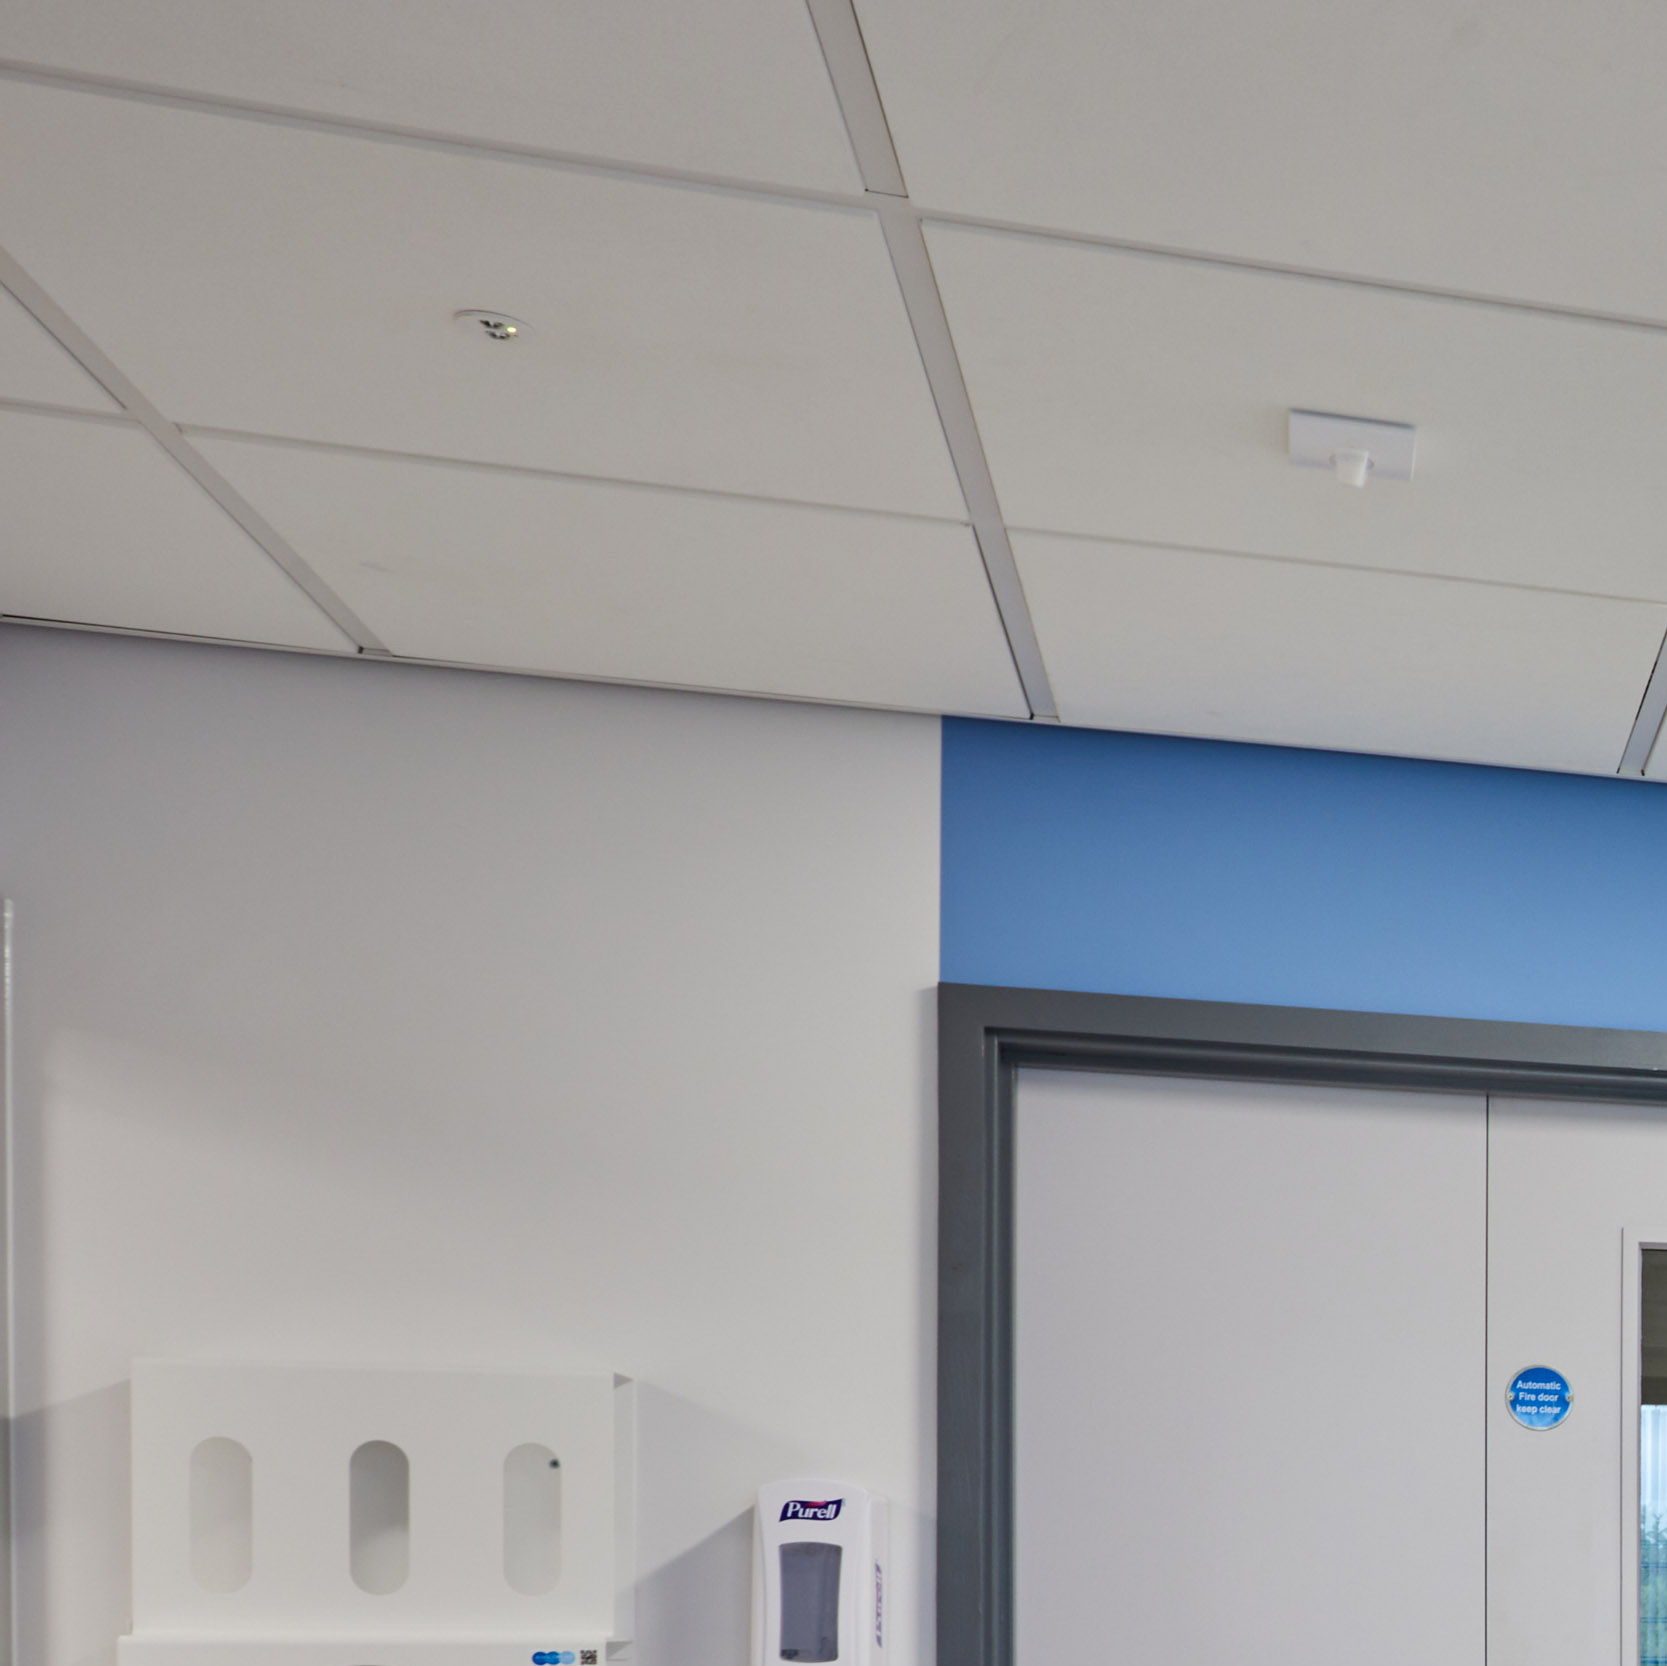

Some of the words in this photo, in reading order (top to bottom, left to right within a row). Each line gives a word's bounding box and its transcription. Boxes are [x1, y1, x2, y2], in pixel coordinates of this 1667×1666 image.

[1516, 1380, 1562, 1390] Automatic
[1518, 1392, 1536, 1401] Fire
[1537, 1393, 1559, 1402] door
[1516, 1404, 1538, 1415] keep
[1539, 1405, 1562, 1414] clear
[787, 1502, 837, 1519] Purell
